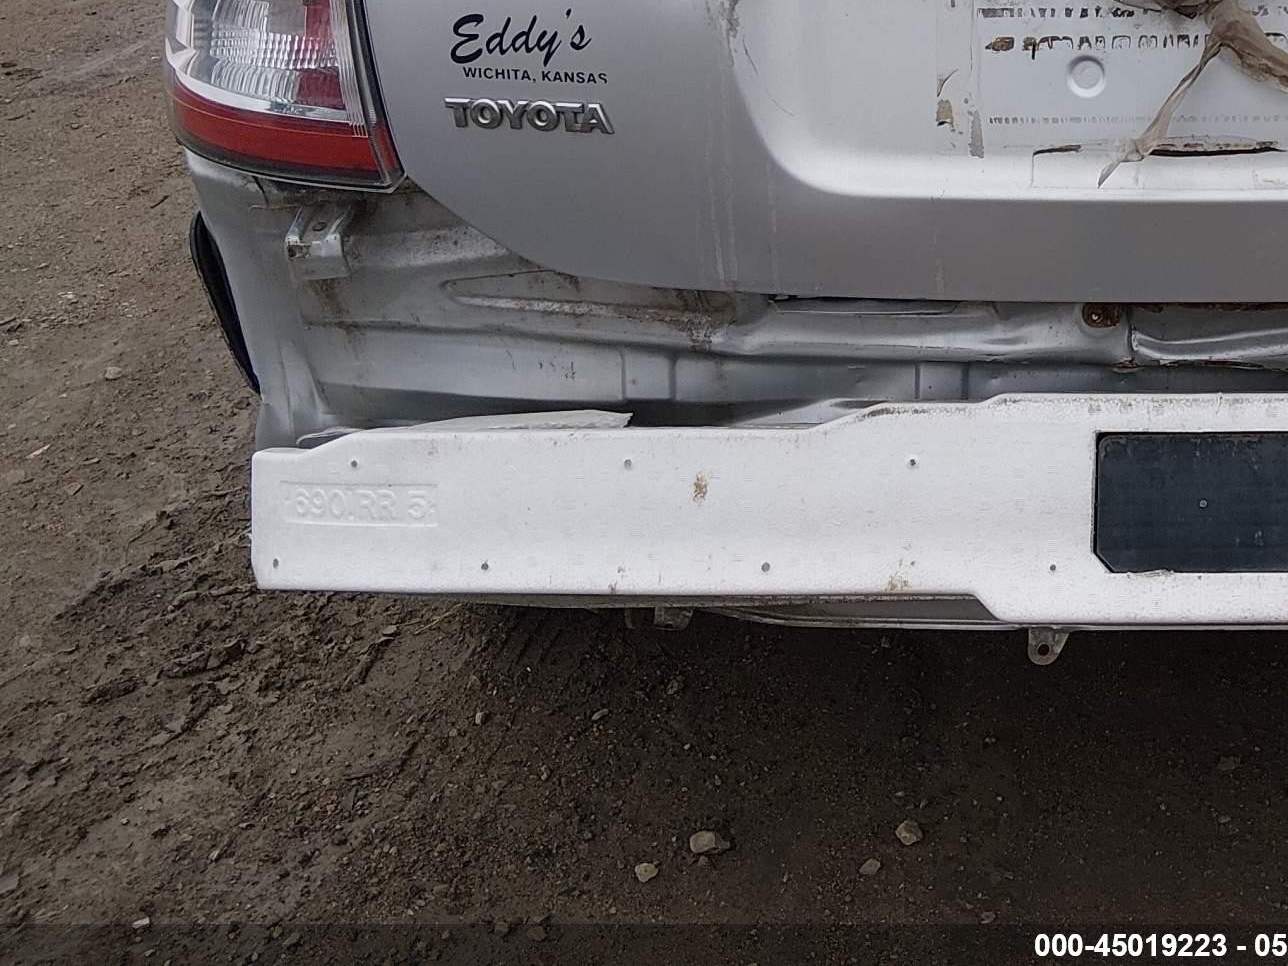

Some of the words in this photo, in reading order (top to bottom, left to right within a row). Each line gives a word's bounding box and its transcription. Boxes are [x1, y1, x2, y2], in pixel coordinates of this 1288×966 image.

[450, 8, 592, 67] Eddy's
[462, 66, 537, 84] WICHITA,
[541, 70, 608, 85] KANSAS
[444, 97, 615, 135] TOYOTA
